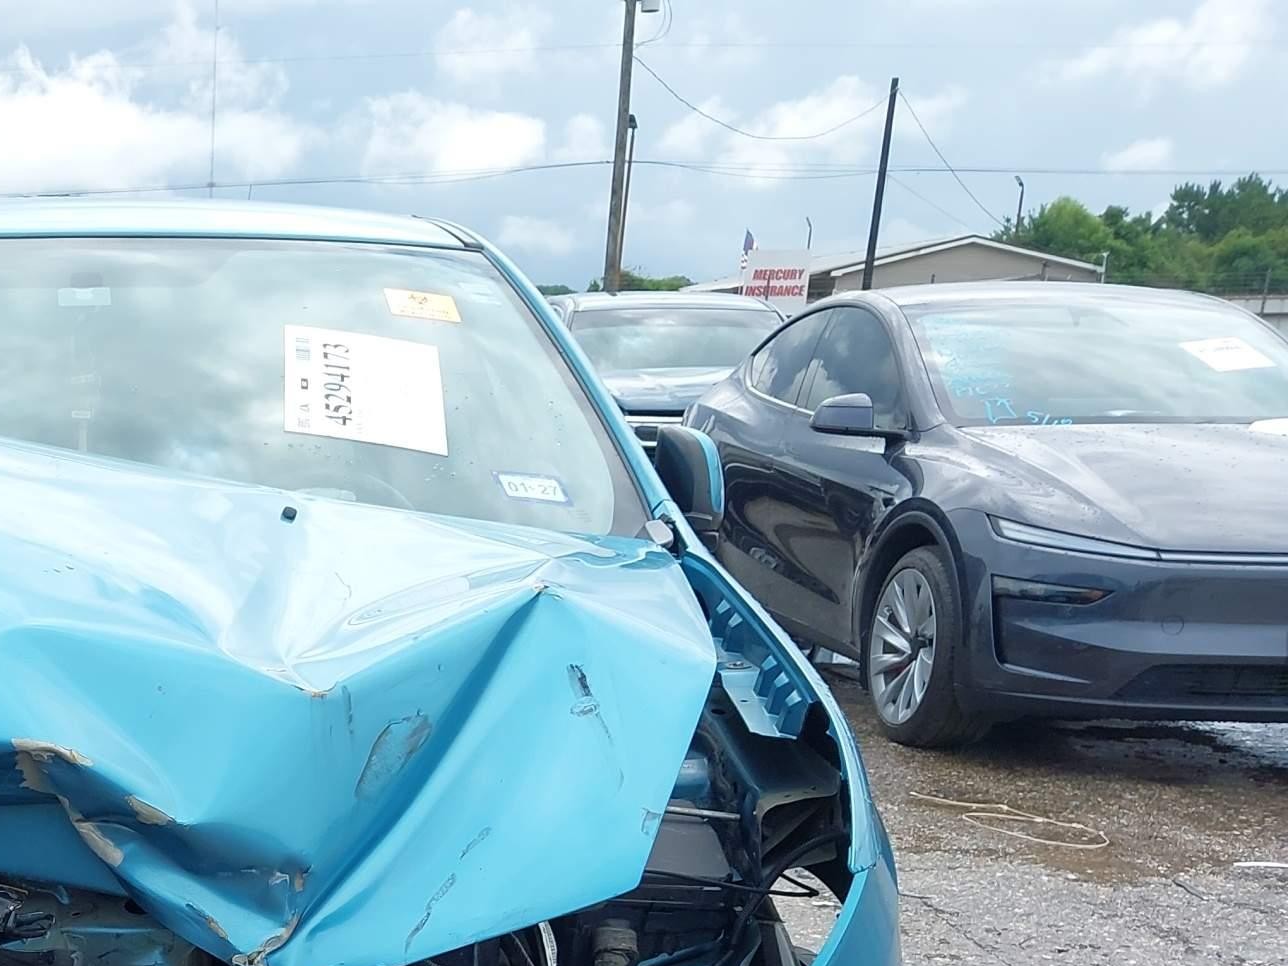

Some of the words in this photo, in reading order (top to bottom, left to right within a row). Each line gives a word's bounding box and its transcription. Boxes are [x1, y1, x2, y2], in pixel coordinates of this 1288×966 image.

[752, 268, 805, 281] MERCURY
[744, 285, 806, 297] INSURANCE
[322, 343, 353, 426] 45294173
